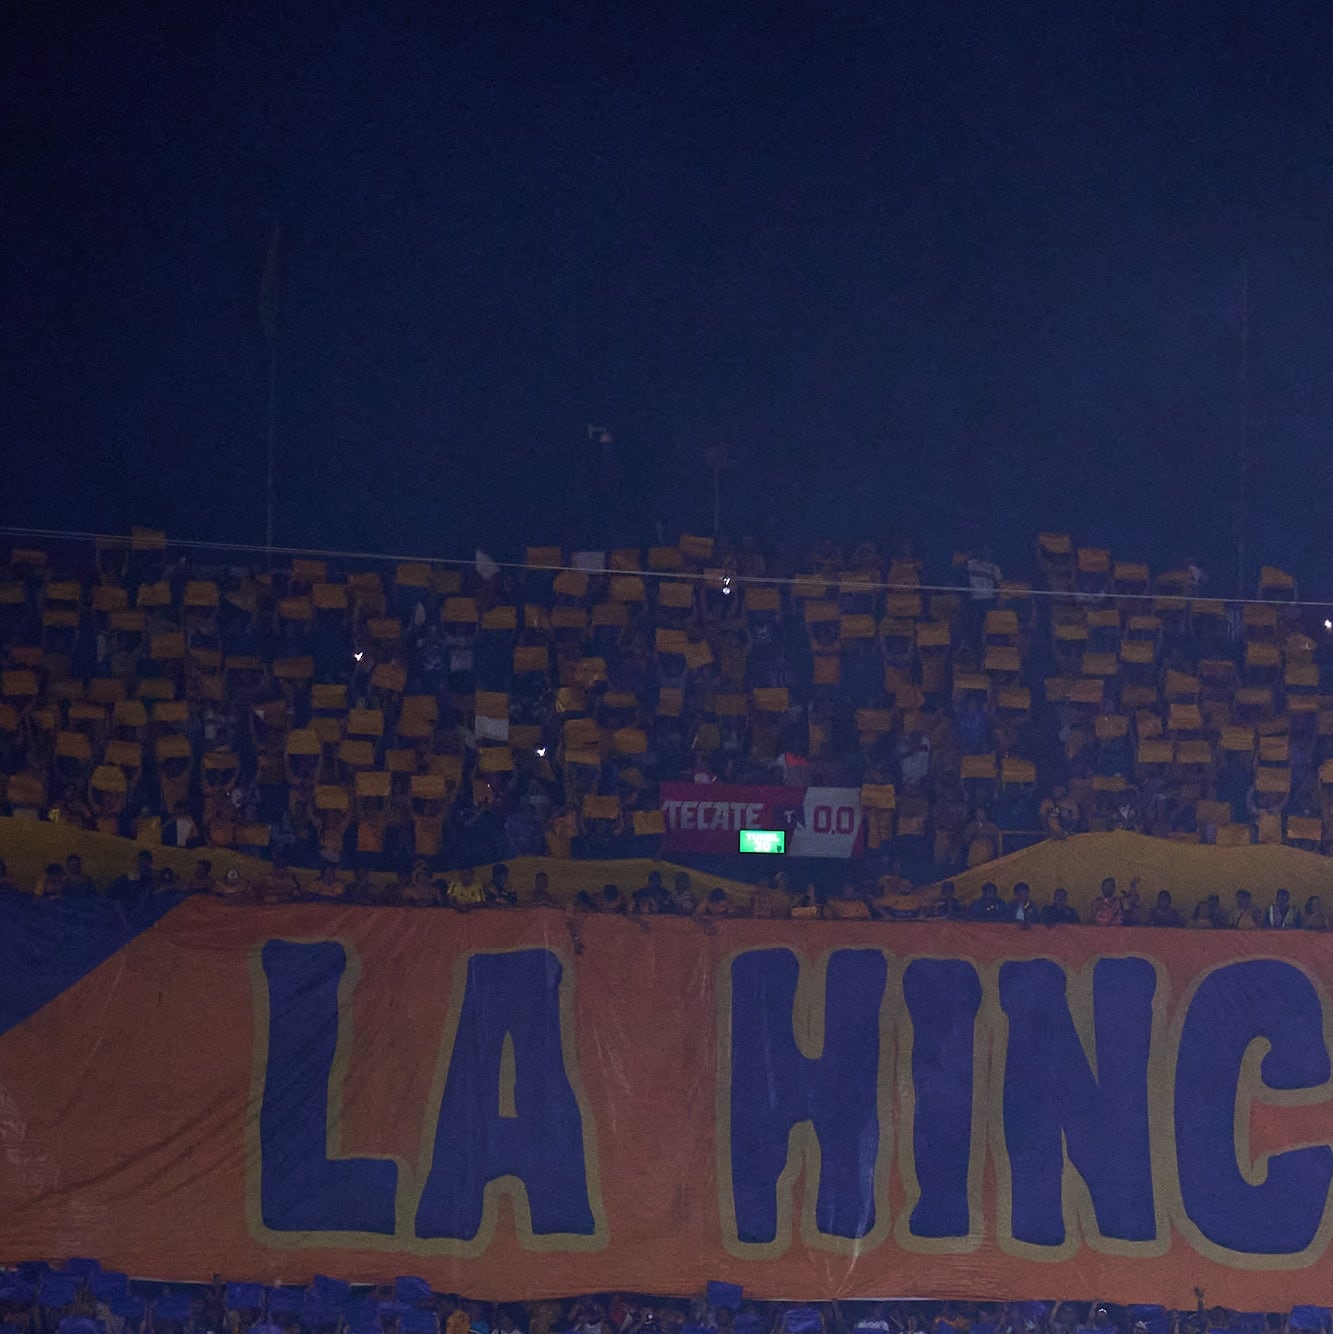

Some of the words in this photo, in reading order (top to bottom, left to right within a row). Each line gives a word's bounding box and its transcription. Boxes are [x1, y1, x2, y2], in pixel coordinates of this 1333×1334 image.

[661, 801, 765, 831] TECATE
[813, 805, 855, 834] 0.0
[247, 932, 609, 1258] LA
